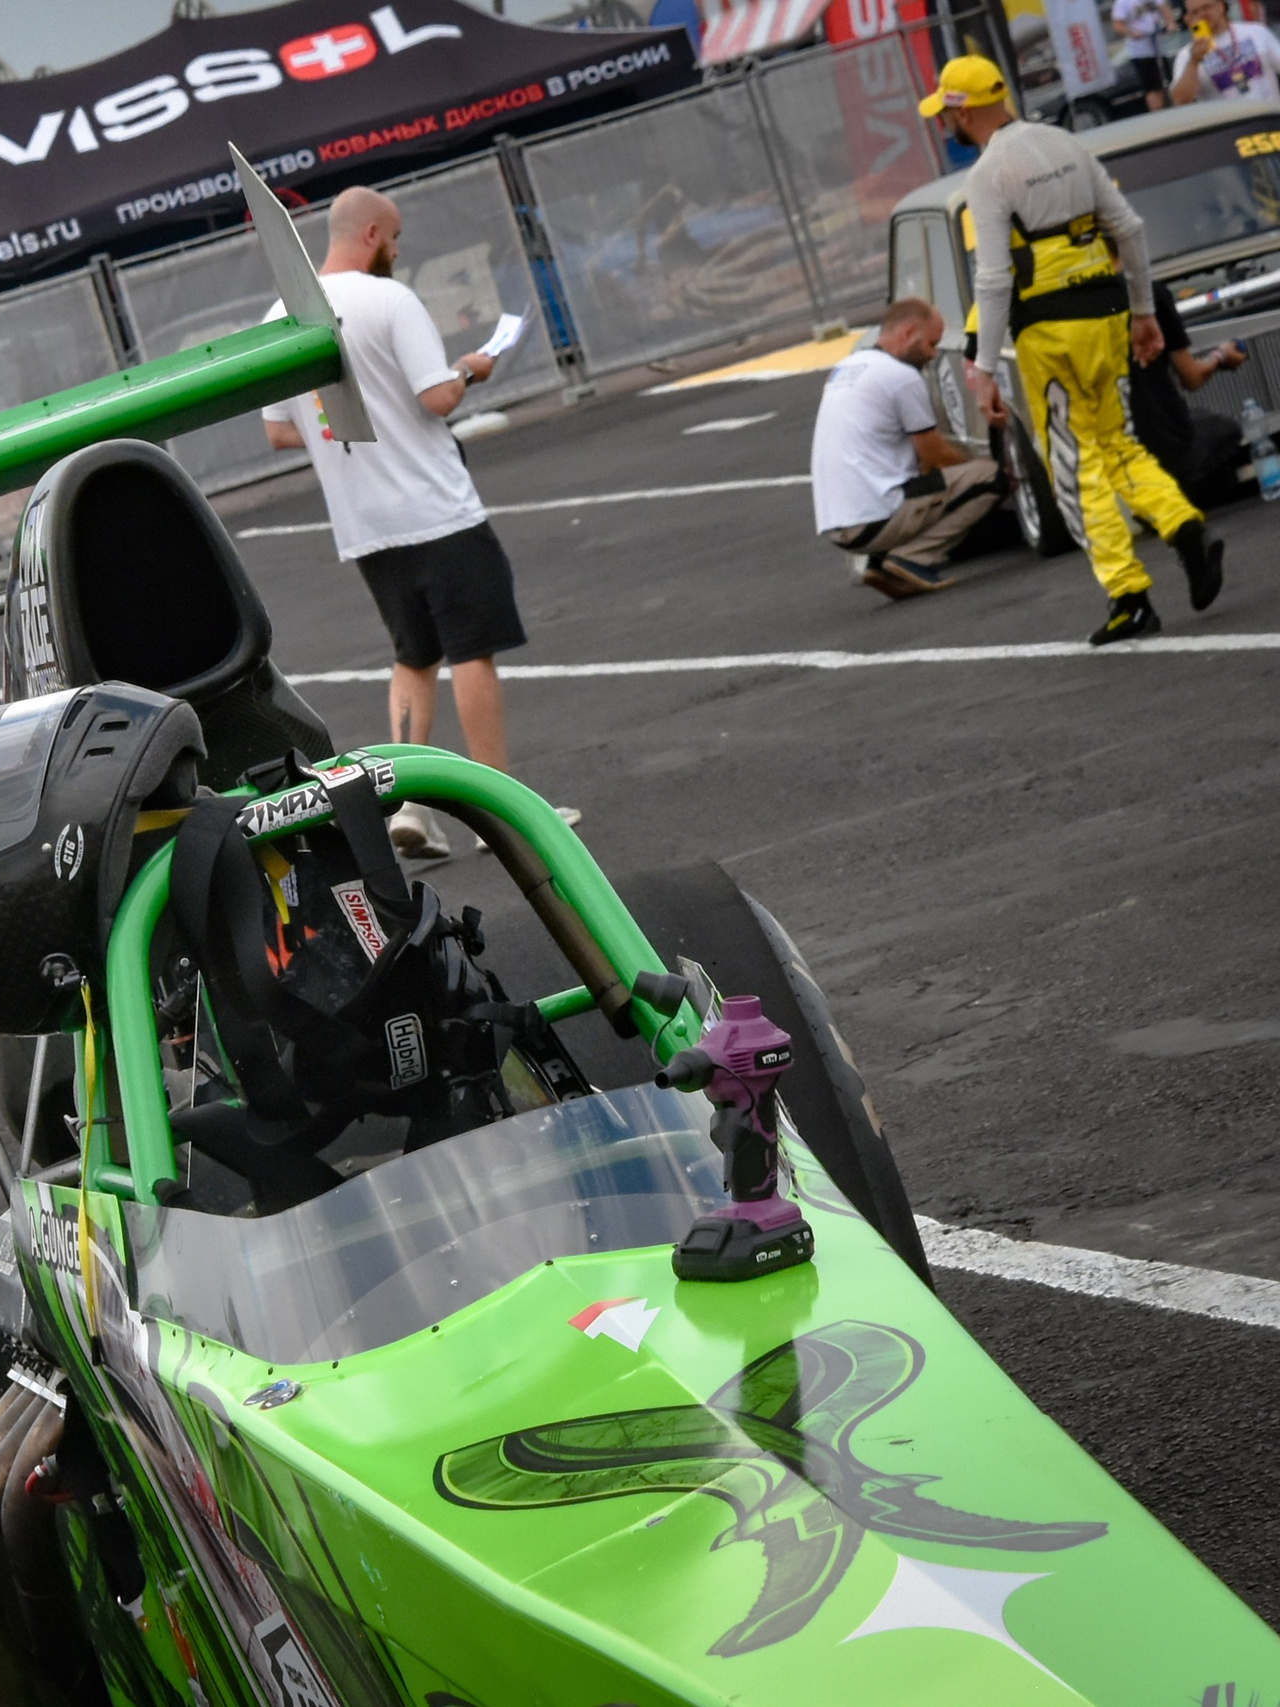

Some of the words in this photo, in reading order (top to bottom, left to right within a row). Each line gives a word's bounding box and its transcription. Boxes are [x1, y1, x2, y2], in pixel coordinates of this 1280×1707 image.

[319, 114, 440, 163] КОВАНЫХ
[444, 82, 546, 131] ДИСКОВ
[547, 76, 566, 97] В
[568, 43, 670, 91] РОССИИ
[394, 1022, 419, 1084] Hybrid
